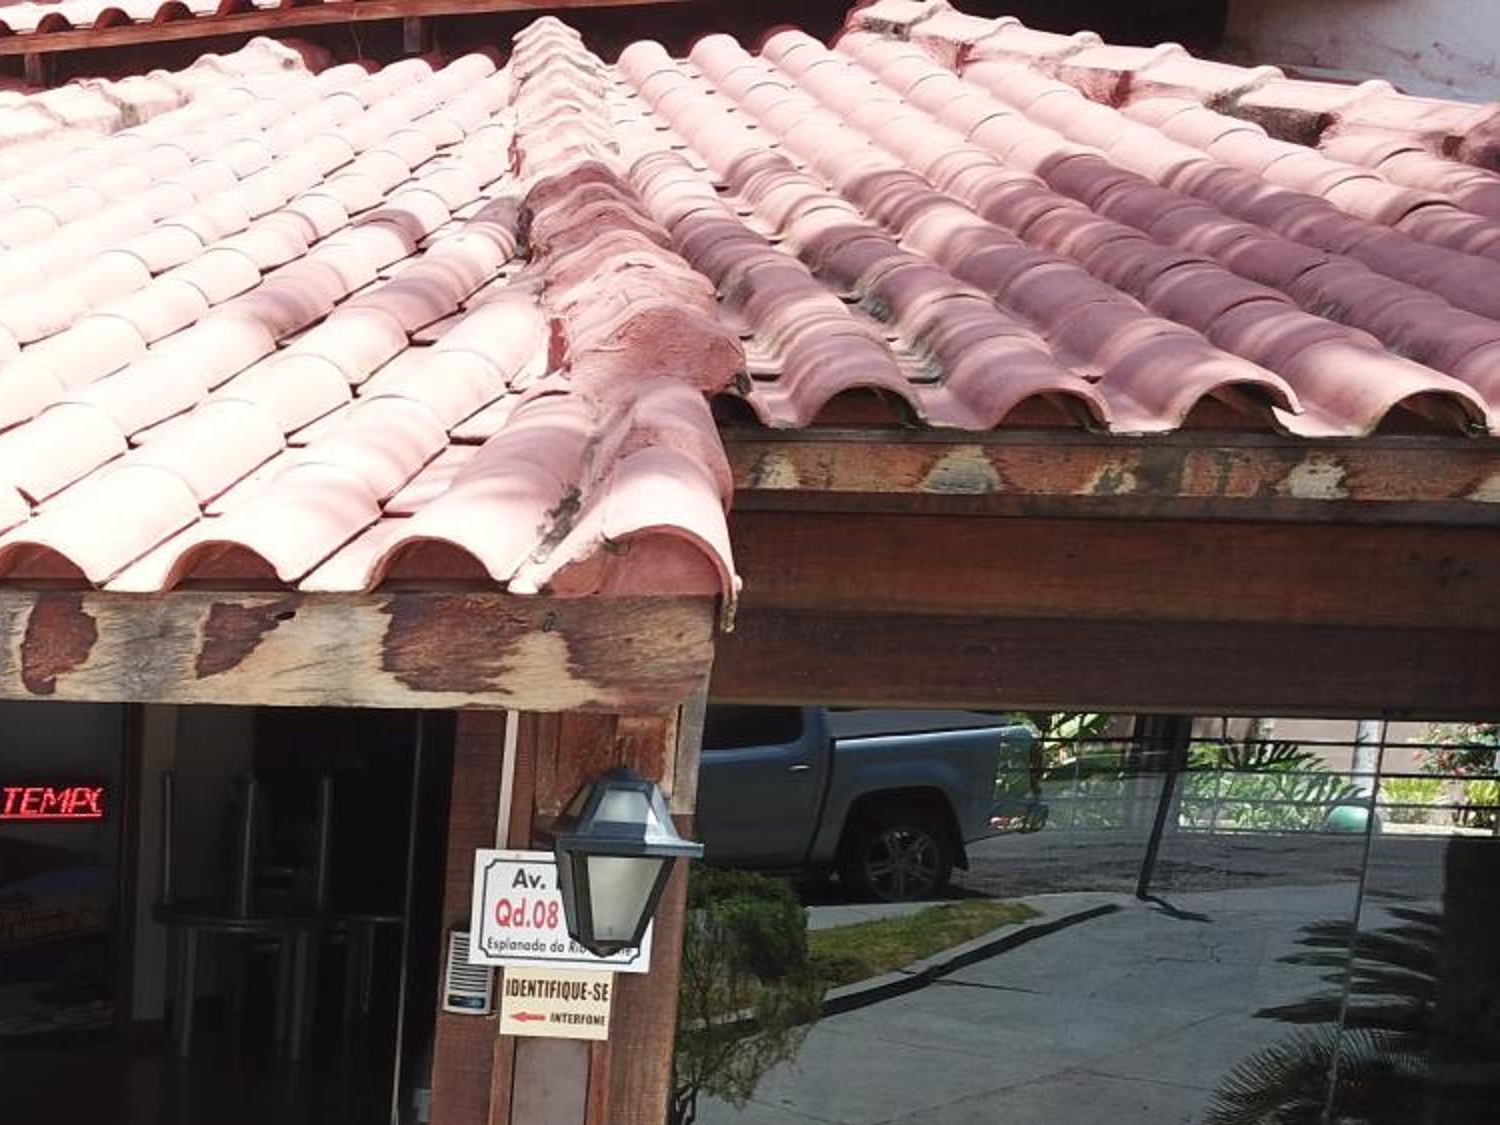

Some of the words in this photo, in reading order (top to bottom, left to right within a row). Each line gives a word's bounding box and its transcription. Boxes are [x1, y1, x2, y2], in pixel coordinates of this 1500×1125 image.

[512, 868, 546, 890] Av.
[495, 898, 559, 929] Qd.08
[506, 979, 609, 1001] IDENTIFIQUE-SE
[550, 1012, 605, 1026] INTERFONE
